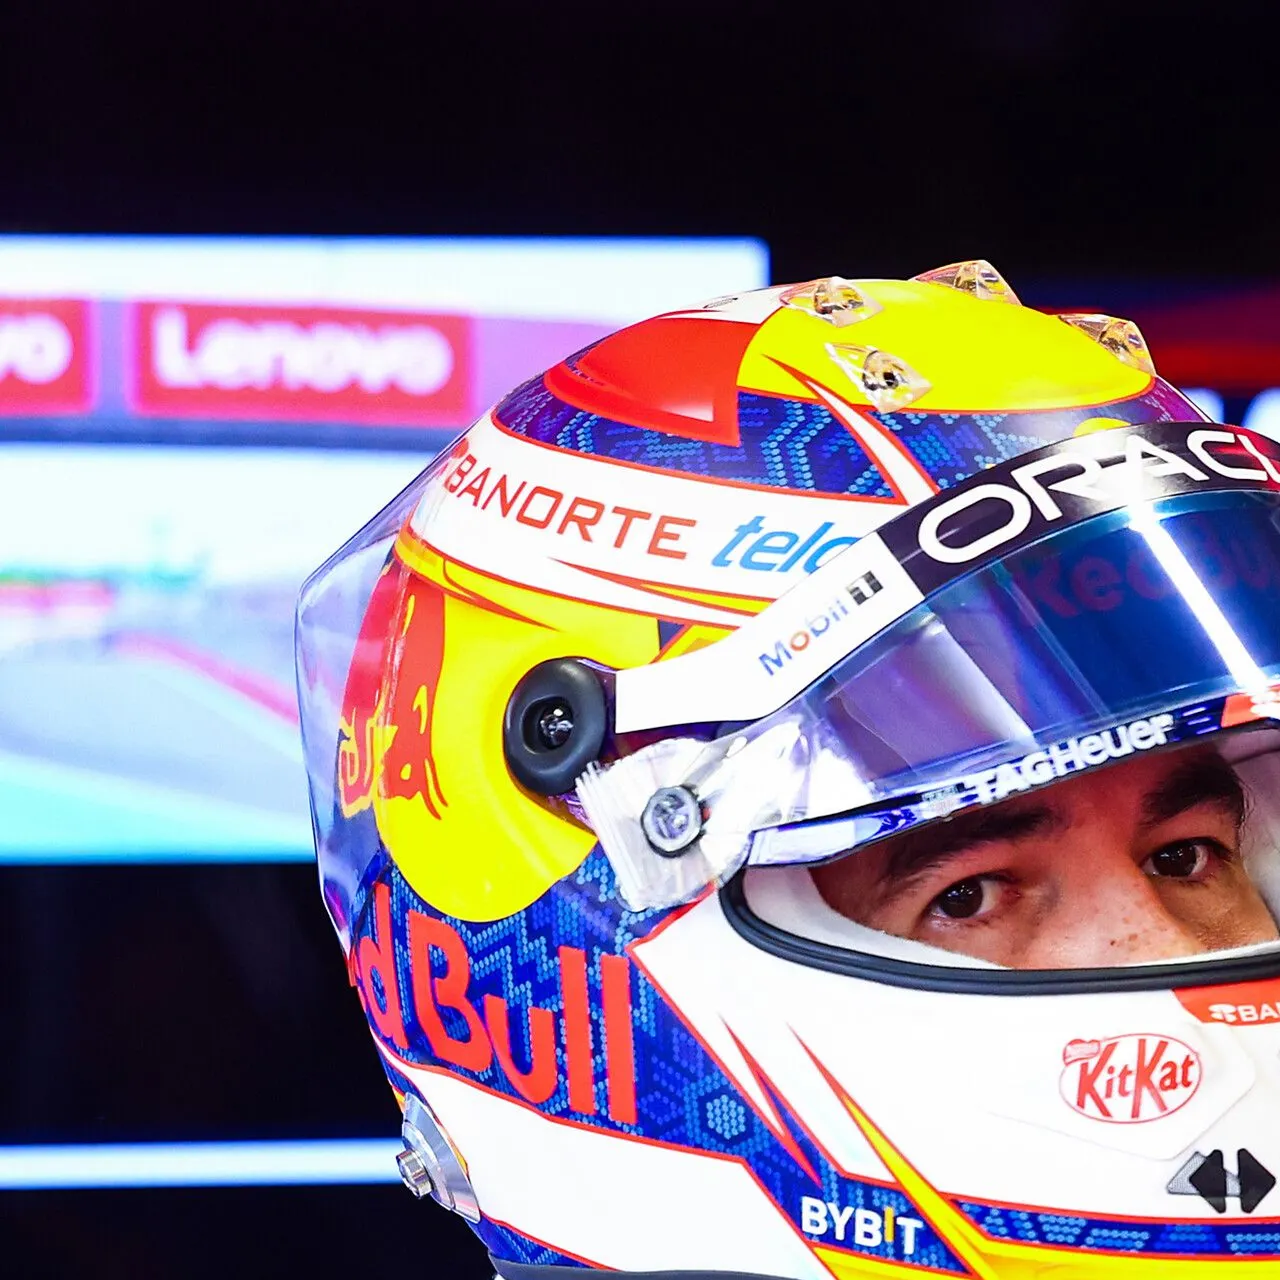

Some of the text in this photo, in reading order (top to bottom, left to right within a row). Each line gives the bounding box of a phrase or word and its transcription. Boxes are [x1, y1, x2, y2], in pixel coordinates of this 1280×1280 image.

[444, 454, 697, 560] BANORTE
[408, 908, 638, 1124] Bull
[1077, 1038, 1194, 1119] KitKat
[802, 1196, 924, 1255] BYBIT
